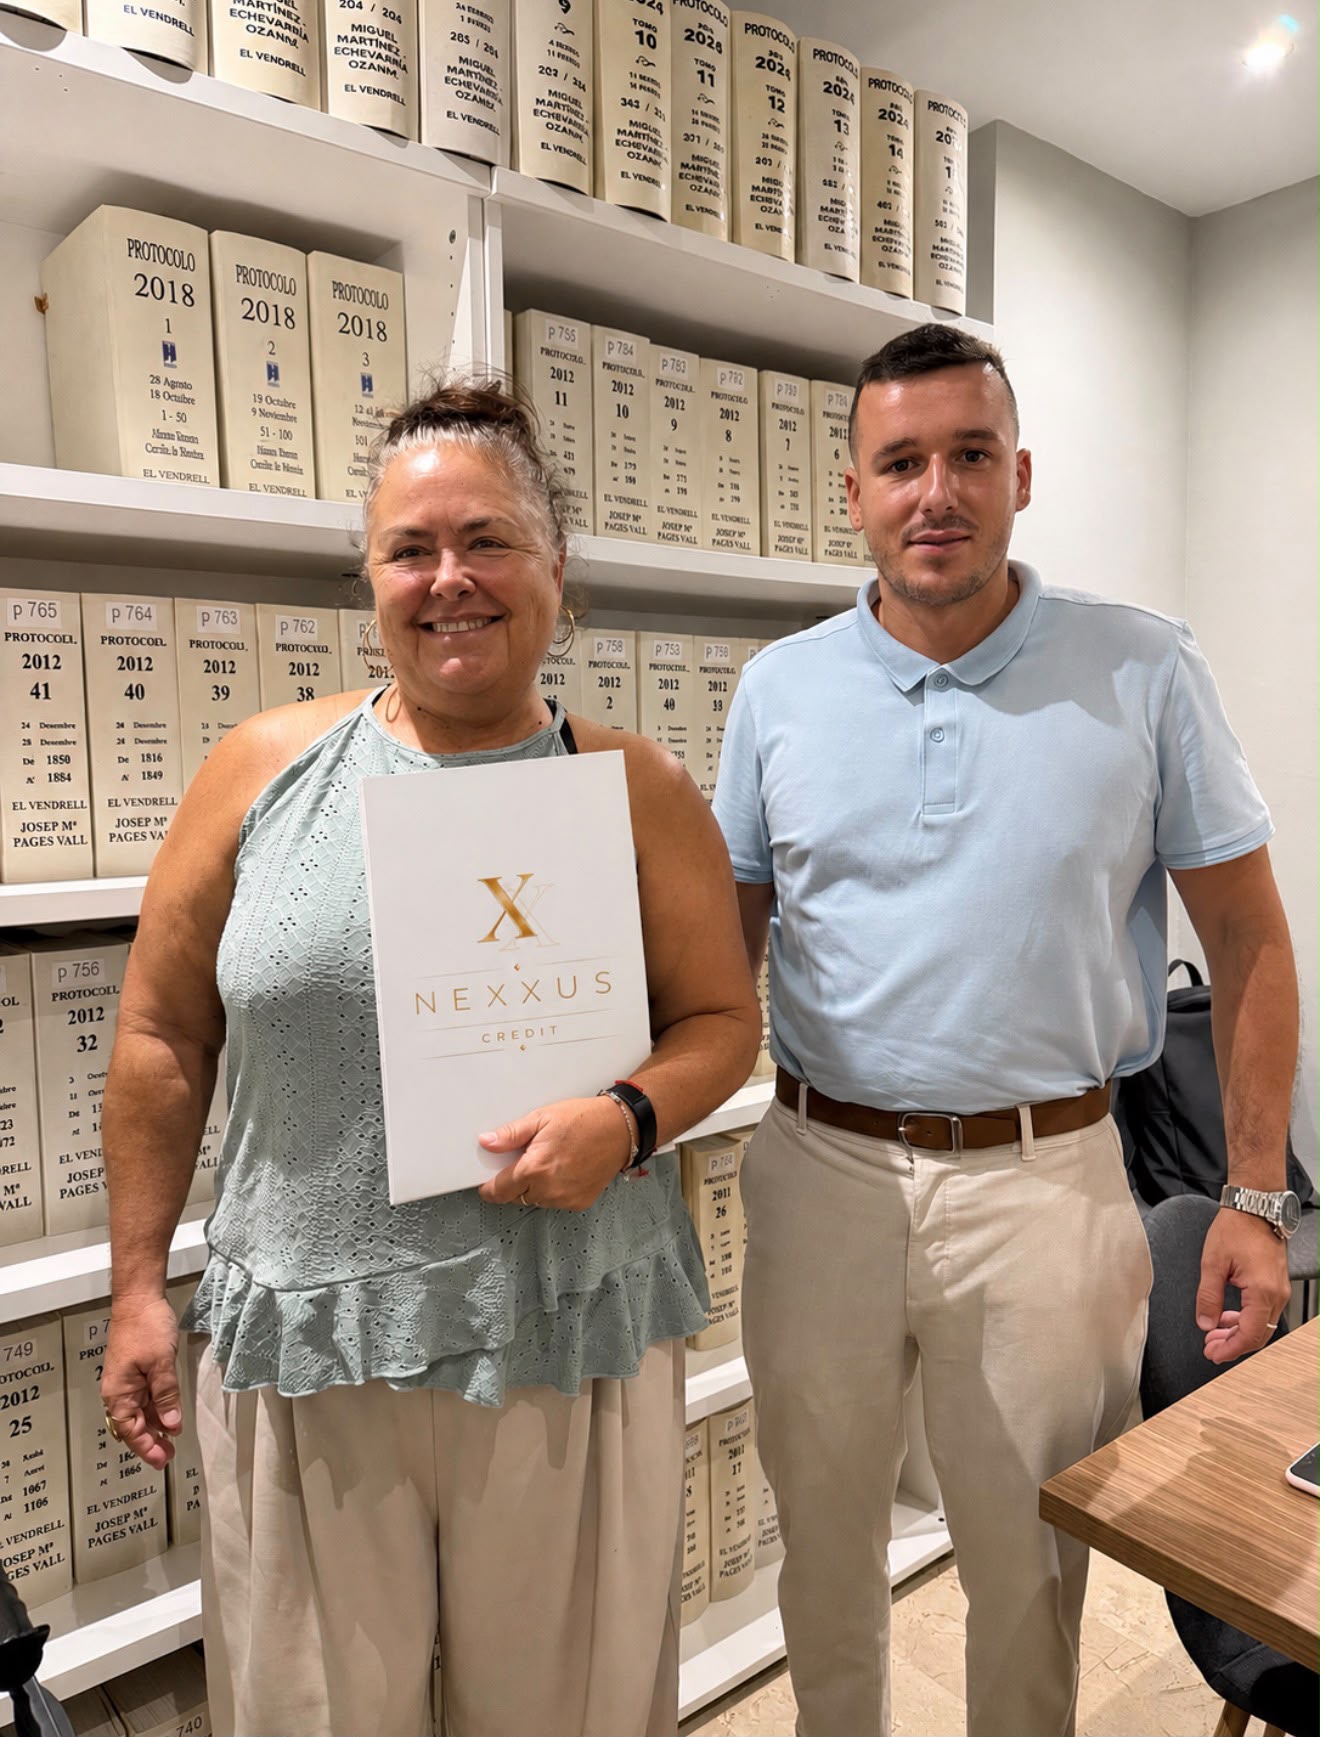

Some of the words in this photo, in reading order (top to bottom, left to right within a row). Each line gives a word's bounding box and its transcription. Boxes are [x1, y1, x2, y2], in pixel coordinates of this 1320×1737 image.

[558, 0, 571, 14] 9
[124, 5, 137, 14] EL
[141, 8, 194, 36] VENDRELL
[633, 18, 657, 33] TOMO
[351, 24, 398, 44] MIGUEL
[635, 30, 657, 50] 10
[240, 49, 252, 58] EL
[256, 52, 306, 76] VENDRELL
[459, 56, 496, 77] MIGUEL
[697, 69, 715, 87] 11
[345, 84, 357, 92] EL
[359, 86, 406, 106] VENDRELL
[548, 90, 582, 109] MIGUEL
[768, 95, 785, 113] 12
[447, 111, 458, 119] EL
[460, 113, 500, 136] VENDRELL
[834, 119, 849, 135] 13
[541, 142, 552, 151] EL
[888, 144, 903, 159] 14
[621, 171, 631, 179] EL
[685, 204, 694, 212] EL
[127, 238, 196, 272] PROTOCOLO
[236, 264, 296, 296] PROTOCOLO
[134, 273, 195, 308] 2018
[332, 280, 389, 310] PROTOCOLO
[241, 298, 295, 330] 2018
[166, 319, 171, 333] 1
[338, 312, 388, 342] 2018
[268, 341, 276, 355] 2
[362, 353, 370, 367] 3
[550, 367, 574, 383] 2012
[150, 389, 160, 399] 18
[612, 380, 634, 396] 2012
[253, 394, 263, 403] 19
[555, 391, 567, 406] 11
[664, 396, 685, 411] 2012
[162, 410, 166, 420] 1
[176, 412, 187, 423] 50
[252, 408, 256, 416] 9
[616, 404, 629, 418] 10
[720, 408, 739, 422] 2012
[671, 418, 677, 431] 9
[779, 419, 797, 432] 2012
[260, 427, 269, 437] 51
[279, 429, 292, 440] 100
[726, 430, 731, 441] 8
[834, 449, 839, 459] 6
[143, 469, 156, 478] EL
[158, 470, 210, 484] VENDRELL
[249, 483, 260, 492] EL
[263, 485, 307, 497] VENDRELL
[604, 494, 612, 502] EL
[614, 495, 648, 507] VENDRELL
[609, 511, 631, 521] JOSEP
[658, 505, 665, 513] EL
[667, 506, 698, 518] VENDRELL
[712, 513, 719, 521] EL
[605, 522, 628, 532] PAGES
[630, 524, 647, 535] VALL
[658, 532, 680, 542] PAGES
[682, 534, 697, 544] VALL
[712, 539, 733, 548] PAGES
[735, 540, 751, 550] VALL
[27, 602, 57, 618] 765
[126, 605, 152, 620] 764
[214, 610, 237, 625] 763
[293, 619, 315, 633] 762
[22, 654, 61, 670] 2012
[117, 656, 153, 671] 2012
[203, 660, 236, 674] 2012
[289, 662, 320, 676] 2012
[540, 673, 565, 685] 2012
[598, 676, 621, 688] 2012
[659, 679, 679, 690] 2012
[708, 681, 727, 692] 2012
[30, 682, 50, 700] 41
[124, 683, 145, 700] 40
[211, 685, 230, 701] 39
[297, 687, 314, 702] 38
[606, 696, 613, 709] 2
[23, 757, 34, 765] De
[47, 755, 70, 765] 1850
[118, 755, 129, 764] De
[141, 753, 162, 763] 1816
[48, 772, 71, 783] 1884
[142, 771, 162, 780] 1849
[12, 801, 29, 811] EL
[31, 800, 87, 810] VENDRELL
[107, 798, 121, 807] EL
[124, 797, 177, 807] VENDRELL
[21, 822, 59, 832] JOSEP
[115, 818, 151, 828] JOSEP
[13, 836, 54, 848] PAGES
[57, 835, 87, 846] VALL
[109, 831, 147, 842] PAGES
[477, 873, 538, 943] X
[73, 961, 100, 978] 756
[416, 971, 611, 1015] NEXXUS
[68, 1007, 104, 1025] 2012
[481, 1025, 558, 1043] CREDIT
[77, 1034, 98, 1052] 32
[59, 1154, 73, 1164] EL
[67, 1168, 105, 1183] JOSEP
[59, 1183, 99, 1199] PAGES
[712, 1187, 731, 1201] 2011
[715, 1206, 726, 1219] 26
[5, 1343, 33, 1361] 749
[0, 1386, 39, 1410] 2012
[9, 1416, 32, 1438] 25
[732, 1462, 741, 1475] 17
[87, 1504, 101, 1515] EL
[103, 1486, 157, 1510] VENDRELL
[95, 1512, 130, 1533] JOSEP
[6, 1520, 65, 1547] VENDRELL
[88, 1530, 126, 1548] PAGES
[130, 1519, 157, 1537] VALL
[33, 1555, 65, 1573] VALL
